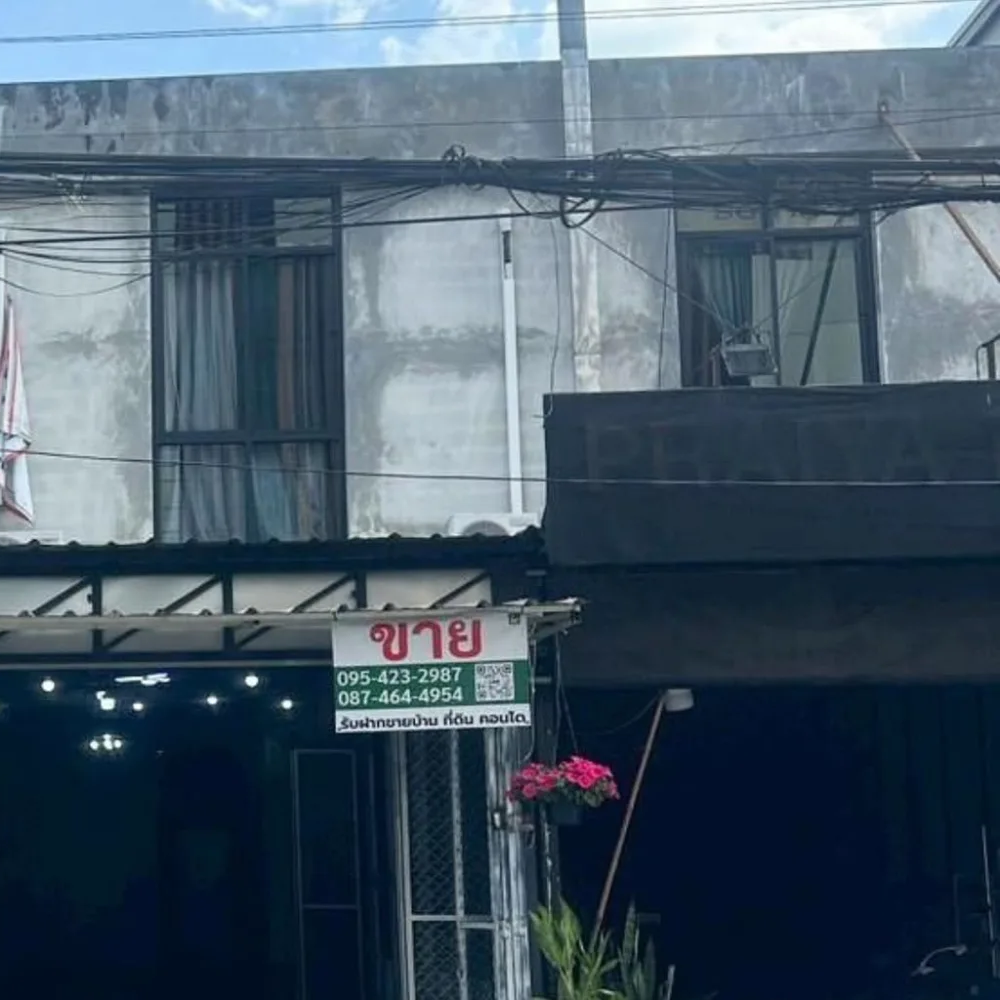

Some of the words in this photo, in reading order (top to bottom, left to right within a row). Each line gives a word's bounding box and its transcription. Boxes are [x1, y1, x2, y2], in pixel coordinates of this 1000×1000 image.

[369, 618, 482, 661] ขาย
[336, 667, 462, 687] 095-423-2987
[338, 687, 463, 707] 087-464-4954
